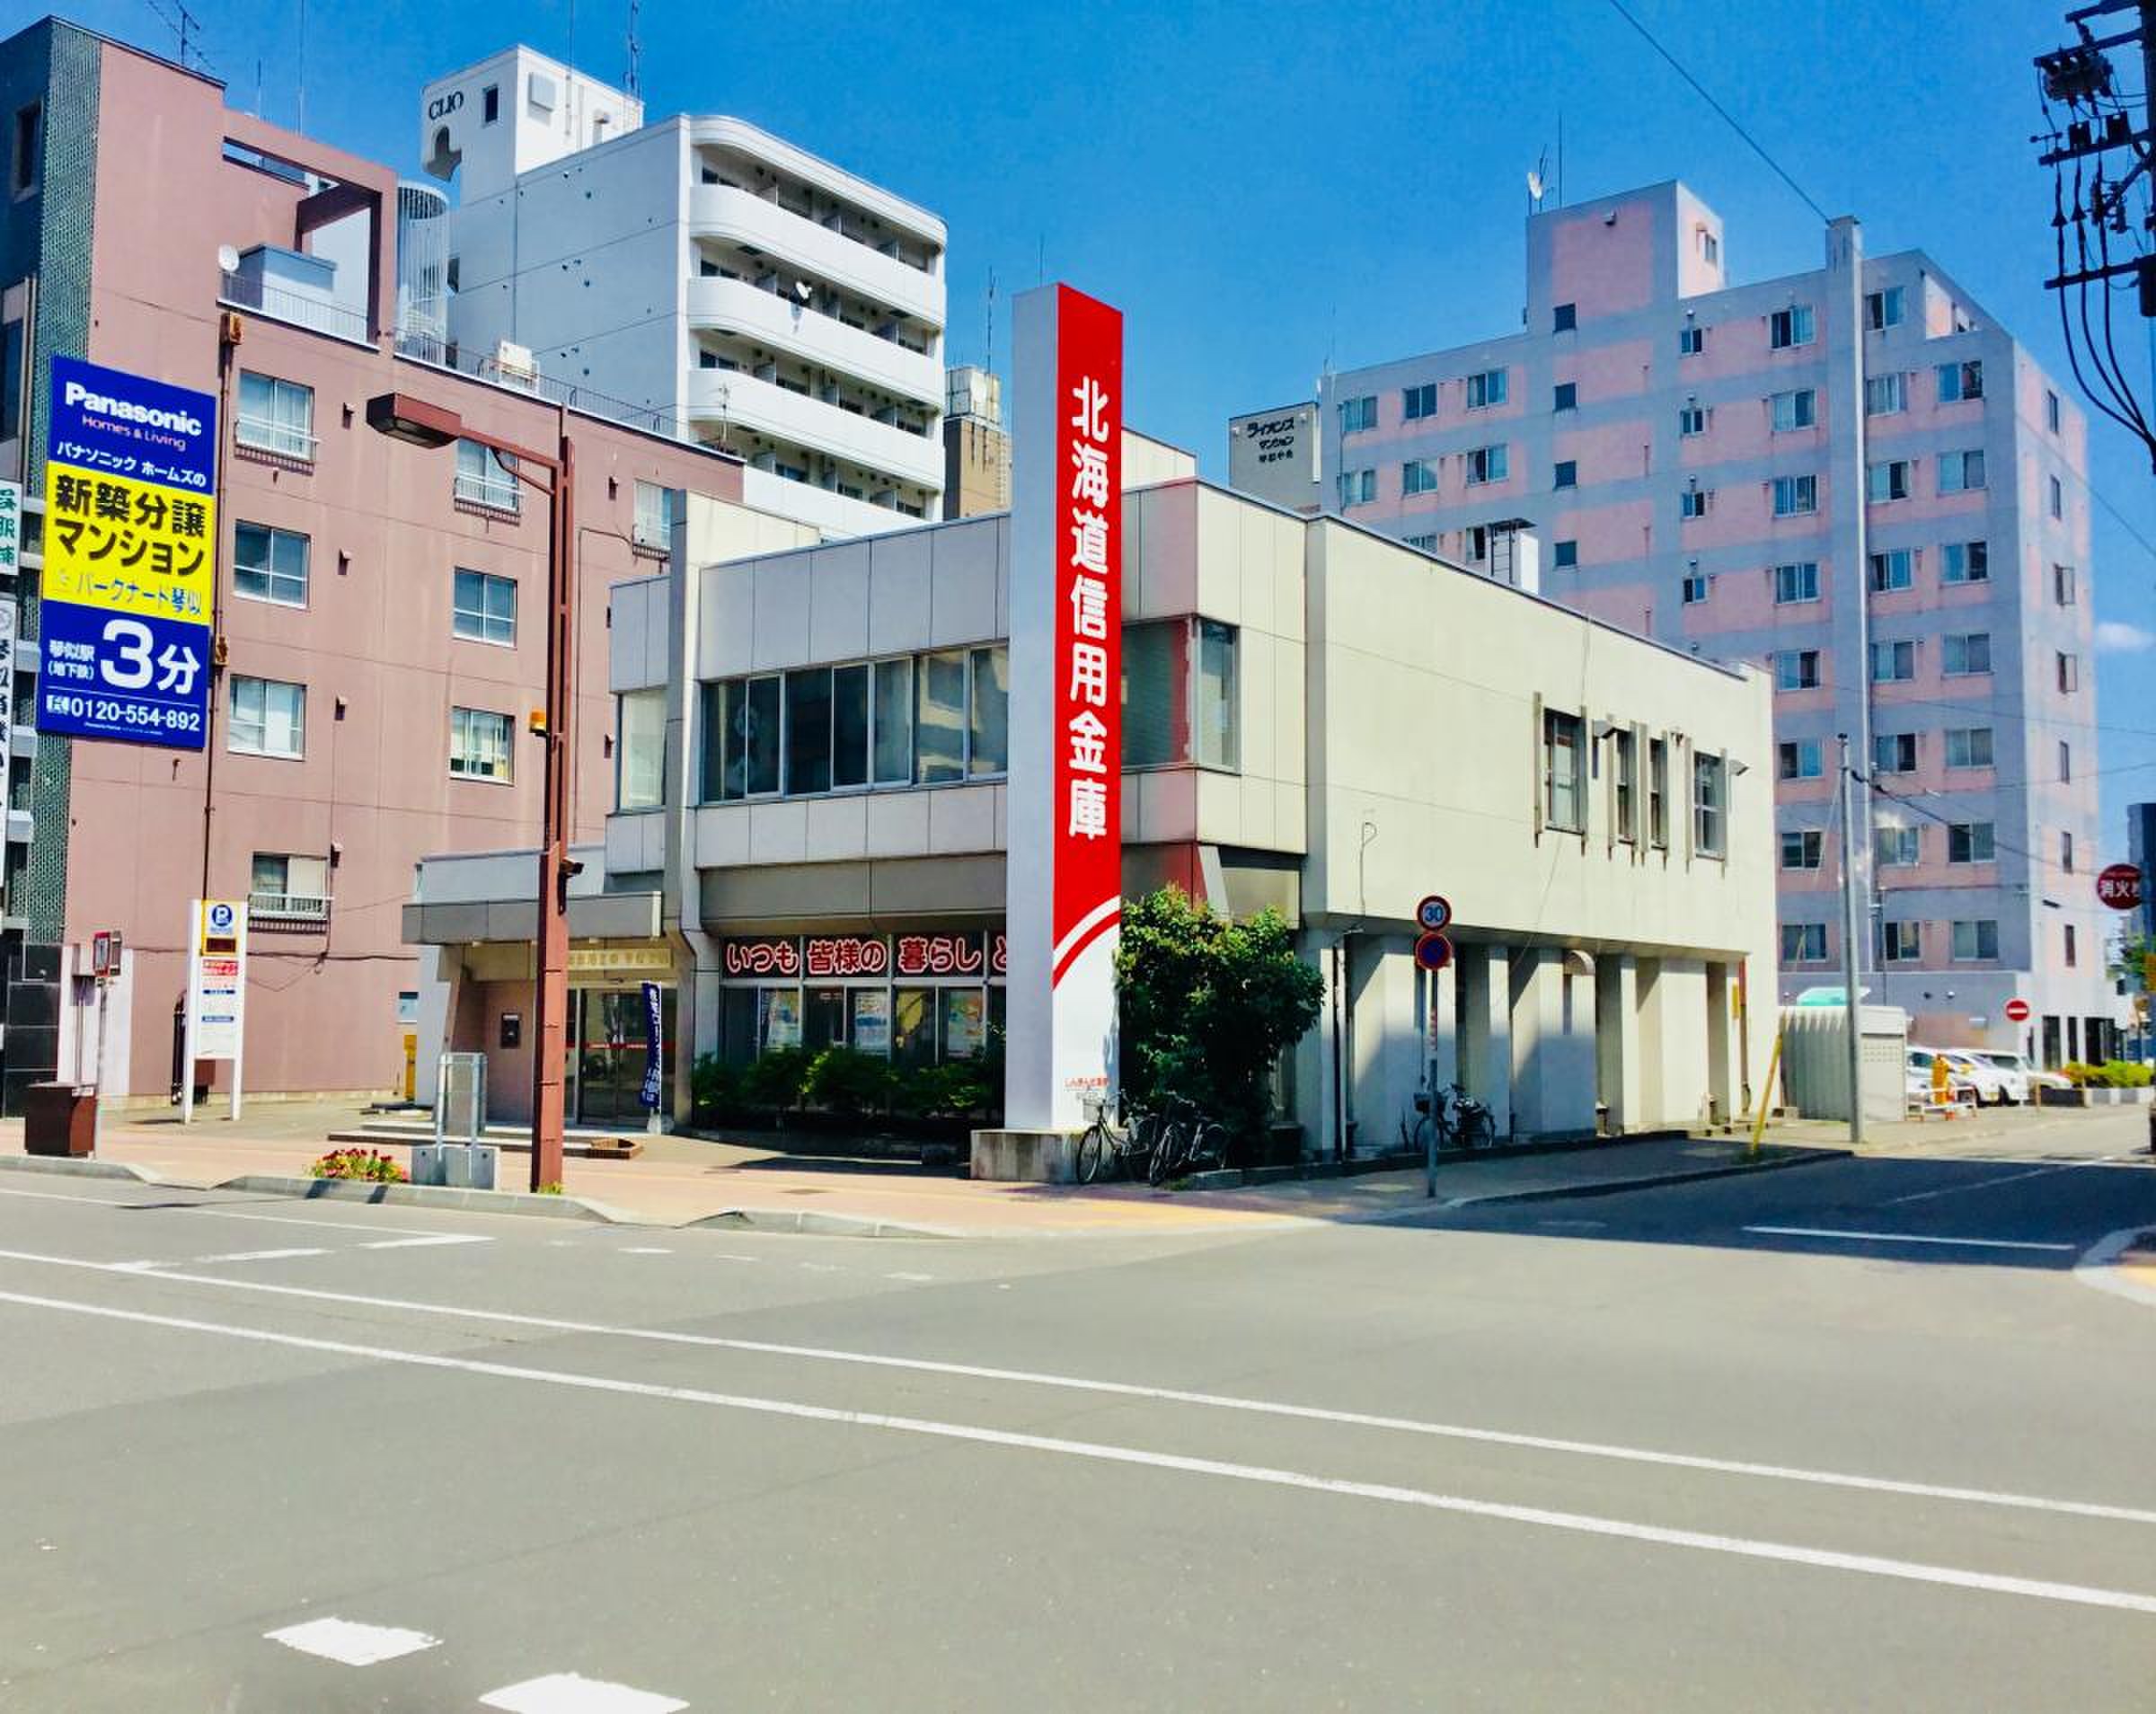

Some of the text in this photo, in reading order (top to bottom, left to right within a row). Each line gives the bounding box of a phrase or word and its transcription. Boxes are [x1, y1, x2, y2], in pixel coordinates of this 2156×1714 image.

[429, 91, 464, 119] CLIO
[66, 381, 201, 437] Panasonic
[83, 414, 186, 452] Homes & Living
[142, 461, 206, 488] ホームズの
[56, 474, 206, 538] 新築分譲
[55, 517, 204, 577] マンション
[1068, 375, 1109, 842] 北海道信用金庫
[100, 618, 201, 694] 3分
[71, 697, 200, 732] 0120-554-892
[1424, 905, 1444, 922] 30
